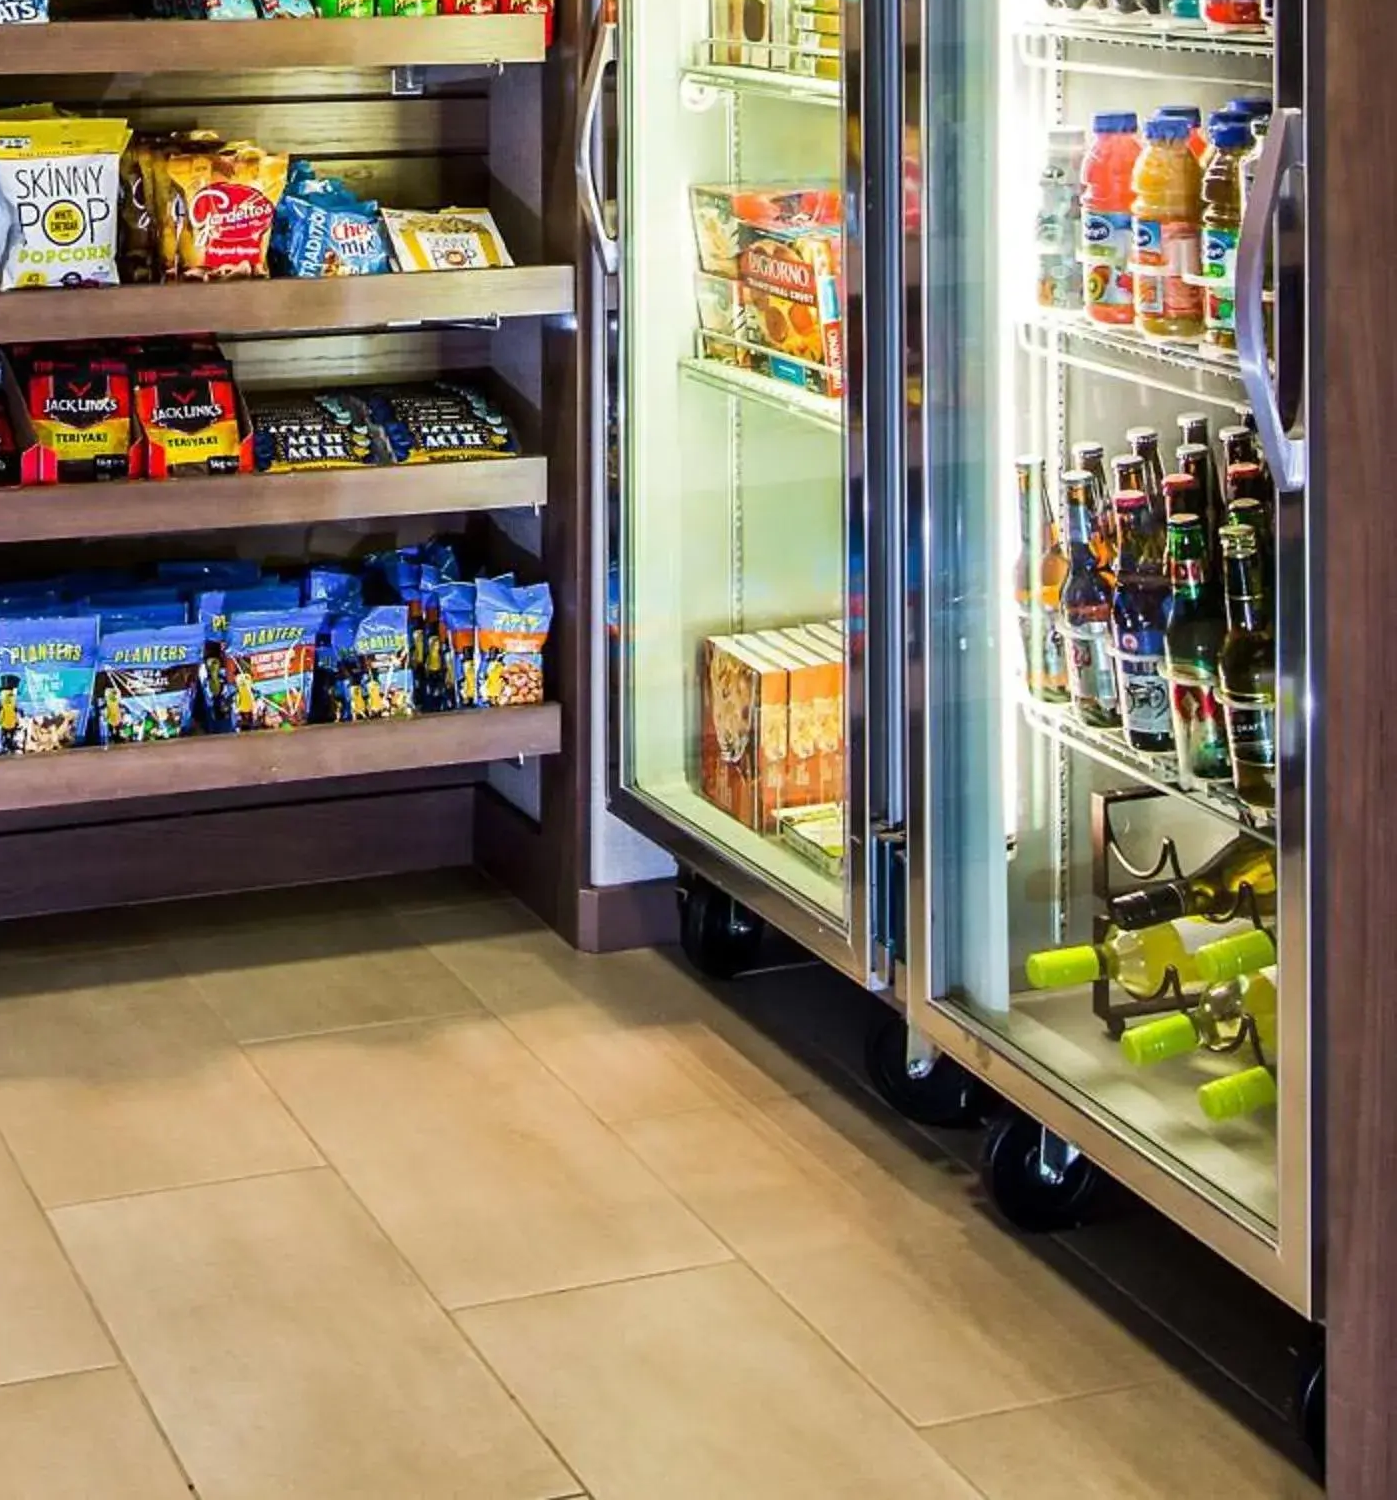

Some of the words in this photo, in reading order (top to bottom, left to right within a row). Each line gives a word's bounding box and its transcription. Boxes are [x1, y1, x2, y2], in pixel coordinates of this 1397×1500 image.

[15, 163, 105, 199] SKINNY
[17, 197, 111, 248] POP
[331, 220, 373, 241] Chex
[17, 243, 112, 264] POPCORN
[43, 399, 77, 413] JACK
[55, 432, 109, 444] TERIYAKI
[166, 436, 218, 448] TERIYAKI
[243, 627, 305, 648] PLANTERS
[10, 643, 83, 665] PLANTERS
[114, 644, 188, 662] PLANTERS
